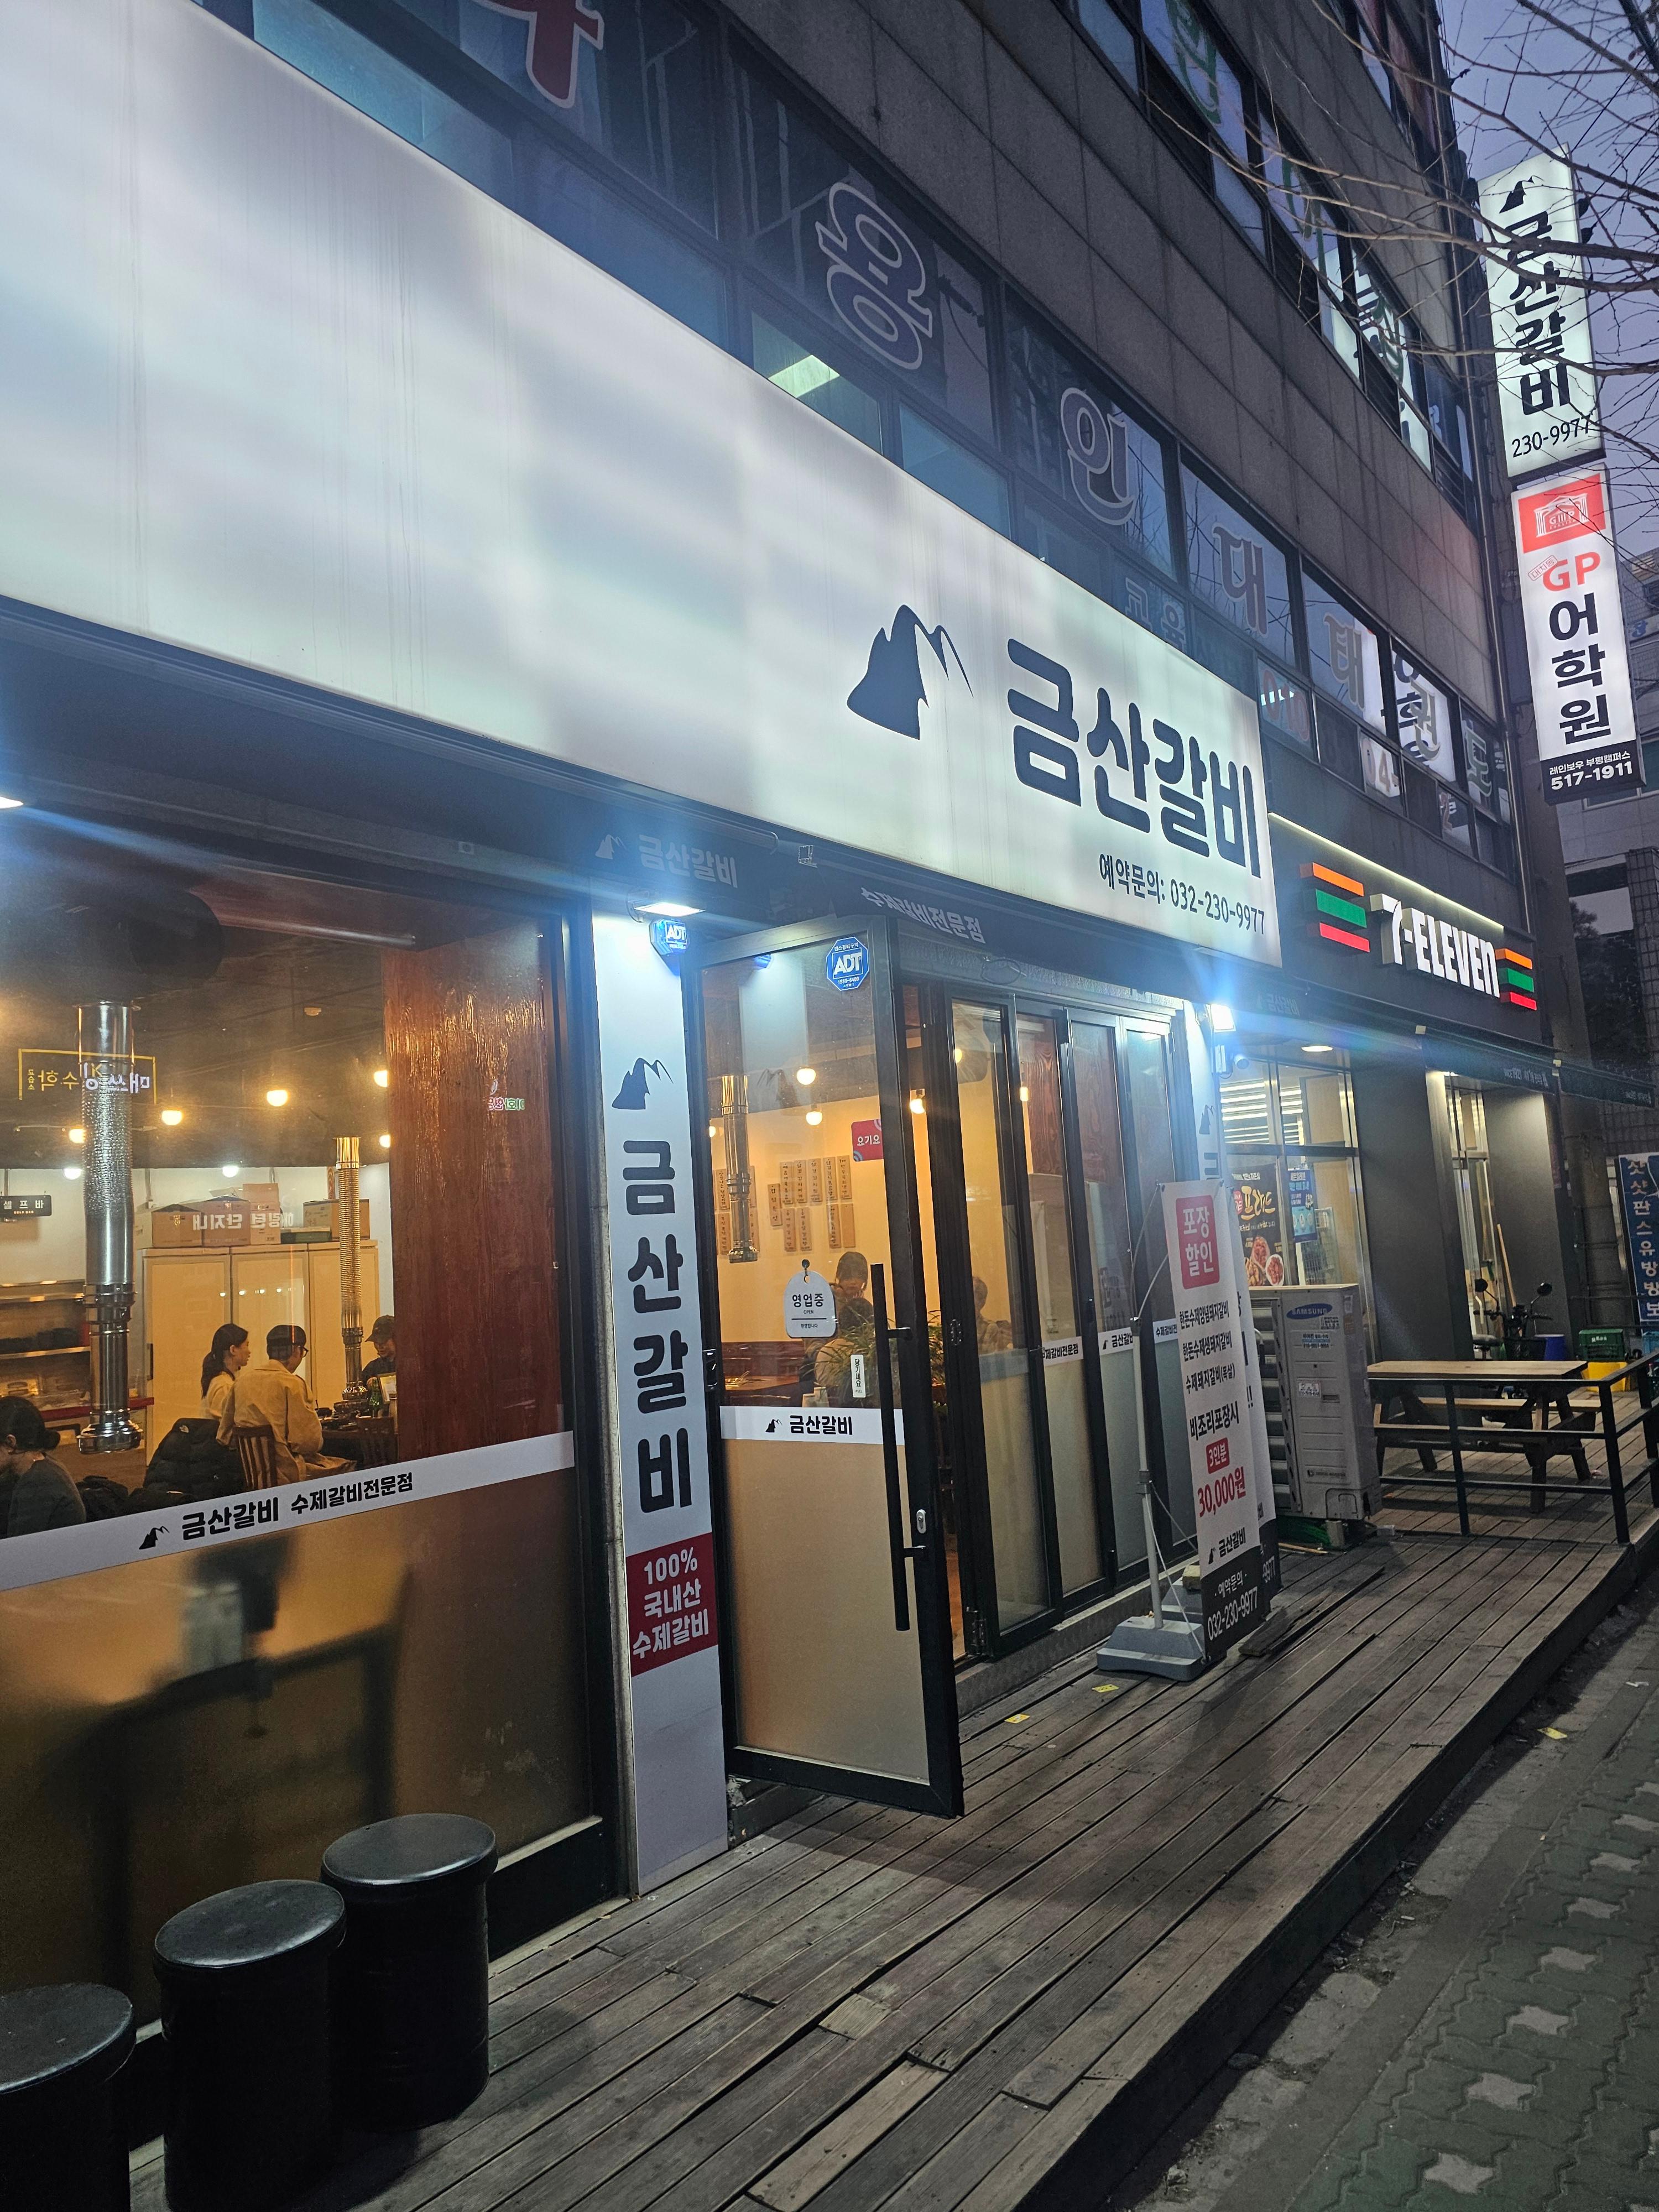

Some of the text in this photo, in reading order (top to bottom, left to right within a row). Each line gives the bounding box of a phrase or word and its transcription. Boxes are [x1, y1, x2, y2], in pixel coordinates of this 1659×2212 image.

[1505, 211, 1571, 415] 금산갈비
[1512, 415, 1592, 458] 230-9977
[1531, 557, 1556, 578] 대치동
[1543, 552, 1601, 592] GP
[1549, 592, 1611, 745] 어학원
[1007, 638, 1261, 878] 금산갈비
[1549, 750, 1631, 776] 레인보우 부평캠퍼스
[1551, 761, 1633, 791] 517-1911
[639, 834, 738, 888] 금산갈비
[1099, 852, 1265, 935] 예약문의: 032-230-9977
[860, 887, 985, 943] 수제갈비전문점
[667, 925, 686, 941] ADT
[833, 952, 862, 975] ADT
[856, 1134, 880, 1147] 요기요
[1182, 1206, 1210, 1239] 포장
[1185, 1241, 1214, 1277] 할인
[792, 1293, 823, 1307] 영업중
[1179, 1300, 1230, 1330] 한돈수제양념돼지갈비
[1292, 1307, 1327, 1316] SAMSUNG
[623, 1140, 692, 1513] 금산갈비
[1182, 1331, 1233, 1361] 한돈수제생돼지갈비
[853, 1358, 862, 1387] 당기세요
[1186, 1363, 1235, 1395] 수제돼지갈비(목살)
[789, 1414, 853, 1436] 금산갈비
[1190, 1401, 1240, 1441] 비조리포장시
[1208, 1442, 1227, 1468] 3인분
[182, 1472, 413, 1541] 금산갈비 수제갈비전문점
[1197, 1466, 1246, 1518] 30,000원
[1218, 1527, 1246, 1558] 금산갈비
[644, 1547, 698, 1585] 100%
[644, 1578, 701, 1618] 국내산
[1218, 1571, 1244, 1598] 예약문의
[1207, 1587, 1259, 1641] 032-230-9977
[633, 1608, 709, 1660] 수제갈비
